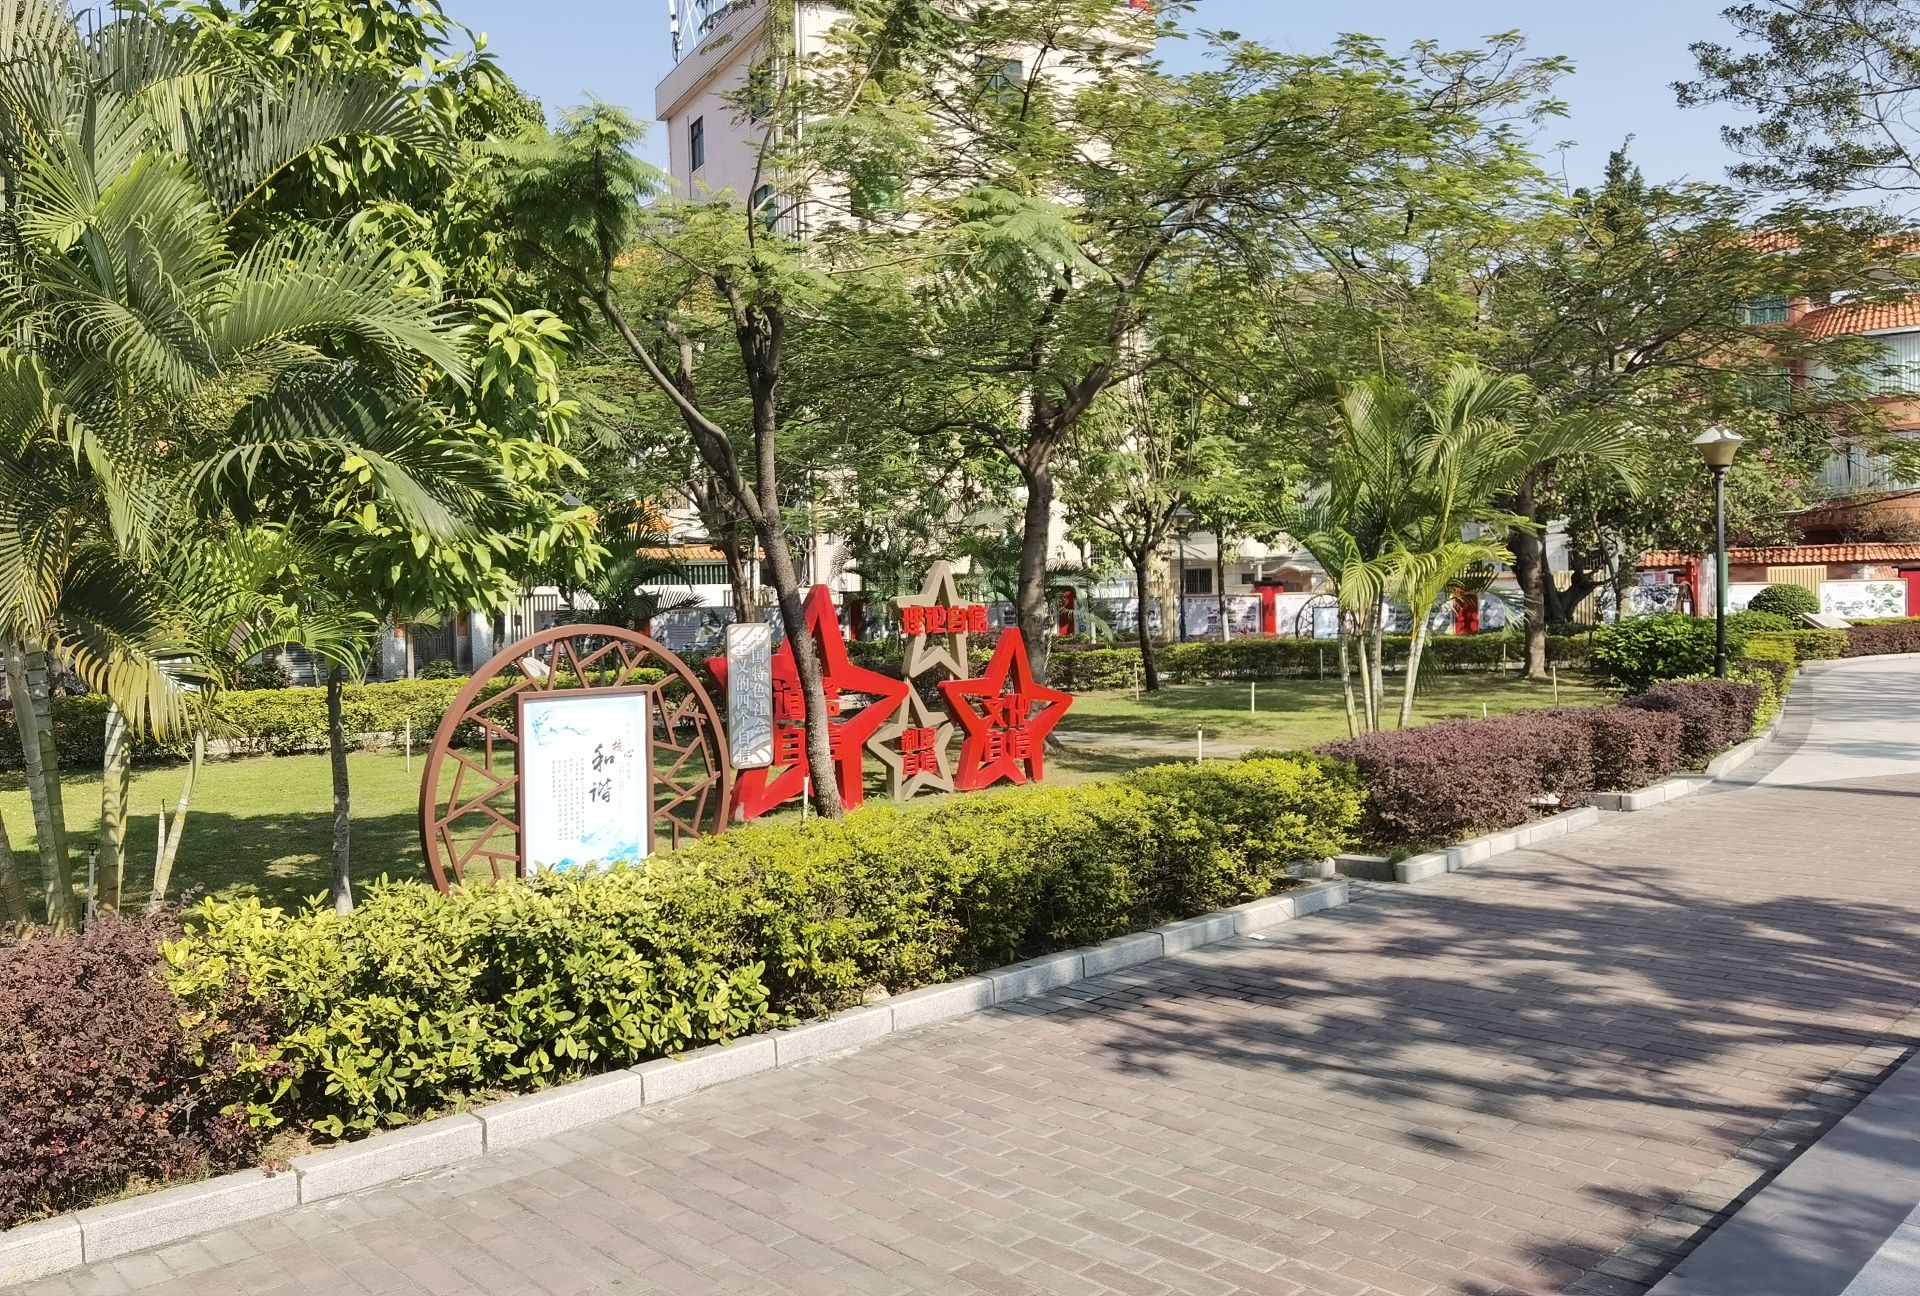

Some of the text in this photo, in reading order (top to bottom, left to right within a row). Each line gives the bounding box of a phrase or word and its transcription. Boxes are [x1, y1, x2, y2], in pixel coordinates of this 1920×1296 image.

[902, 605, 989, 635] 理论自信
[751, 632, 767, 734] 中国特色社会
[736, 640, 751, 765] 主义的四个自信
[981, 694, 1031, 727] 文化
[902, 728, 937, 752] 制度
[985, 728, 1031, 762] 自信
[589, 743, 615, 803] 和谐
[903, 752, 937, 776] 自信
